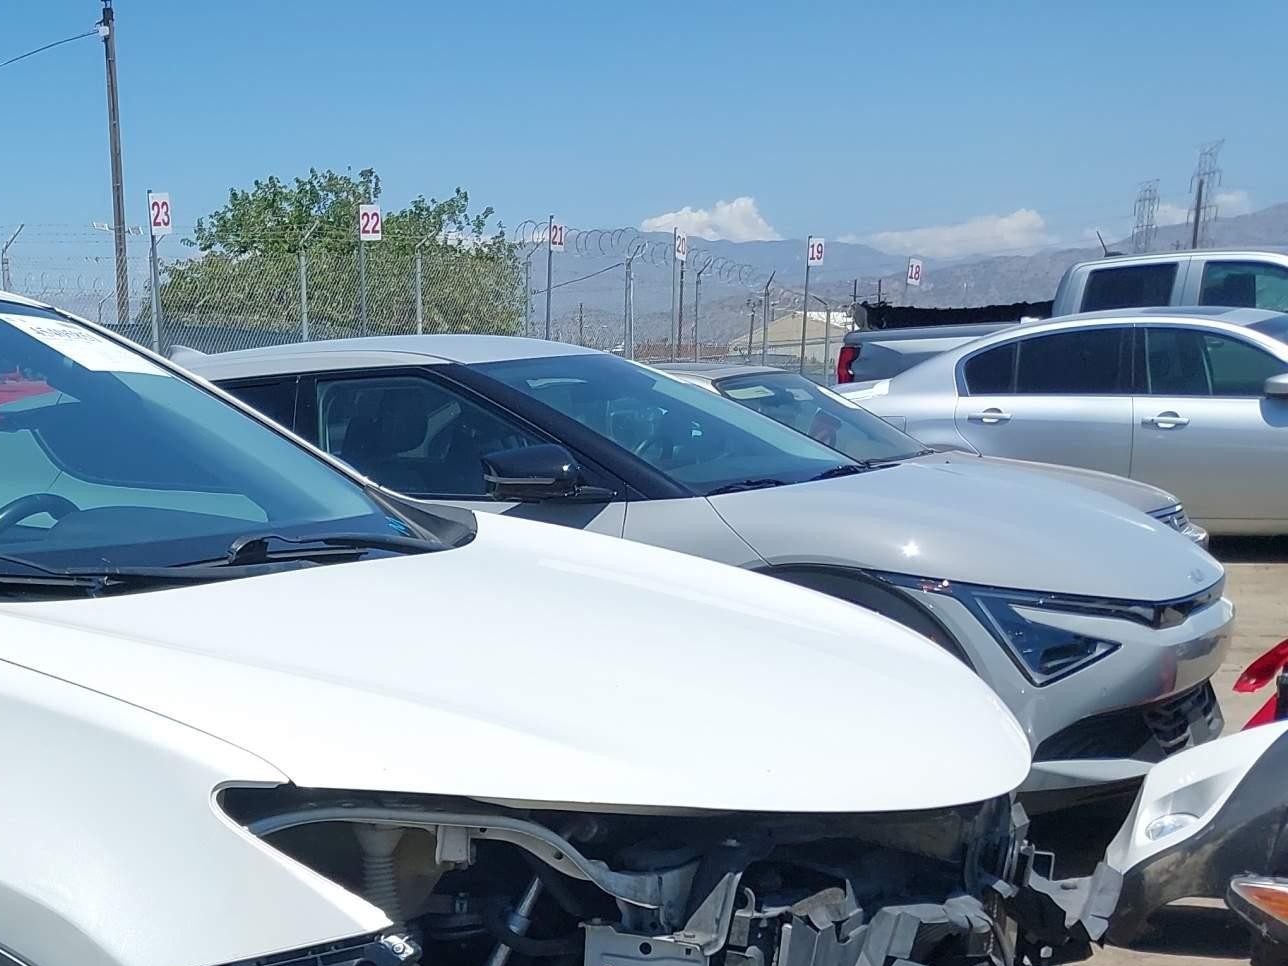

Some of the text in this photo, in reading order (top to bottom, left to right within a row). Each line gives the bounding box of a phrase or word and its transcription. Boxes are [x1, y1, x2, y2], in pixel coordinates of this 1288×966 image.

[151, 201, 171, 227] 23
[361, 212, 380, 234] 22
[551, 225, 565, 245] 21
[676, 234, 687, 256] 20
[809, 243, 824, 261] 19
[908, 263, 921, 281] 18
